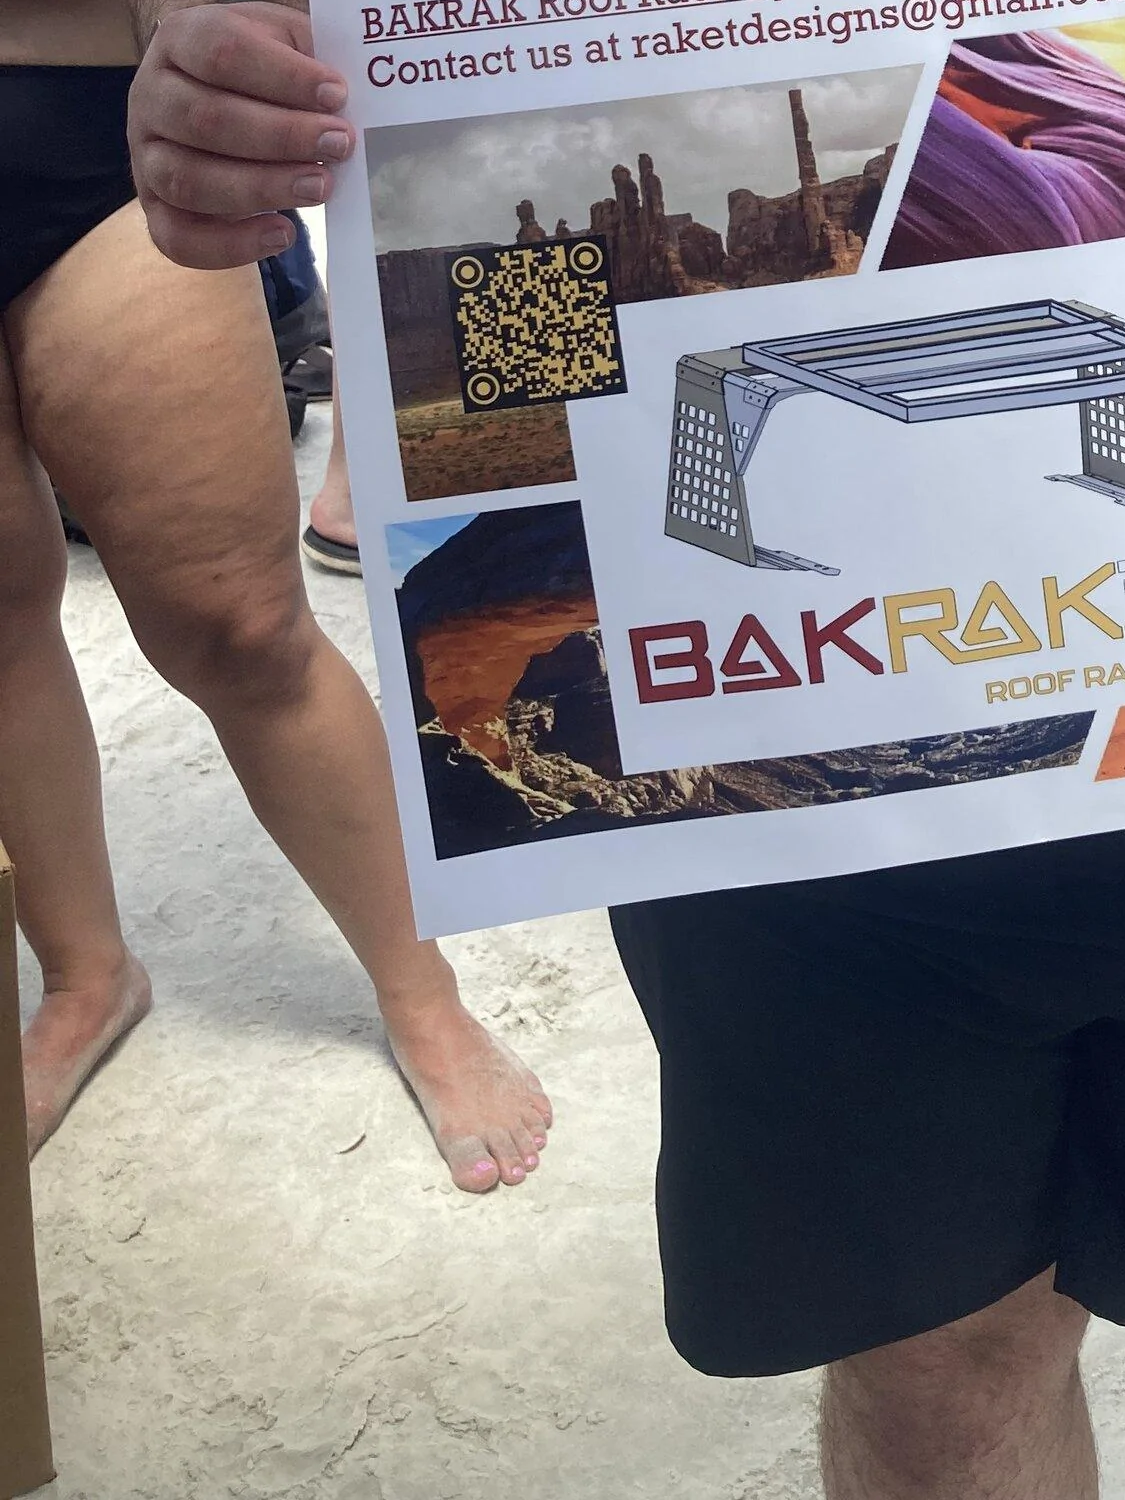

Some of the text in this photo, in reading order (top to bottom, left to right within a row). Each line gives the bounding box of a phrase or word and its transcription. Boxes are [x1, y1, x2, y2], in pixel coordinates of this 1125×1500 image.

[367, 44, 516, 87] Contact
[527, 43, 572, 70] us
[585, 32, 621, 63] at
[985, 670, 1077, 703] ROOF
